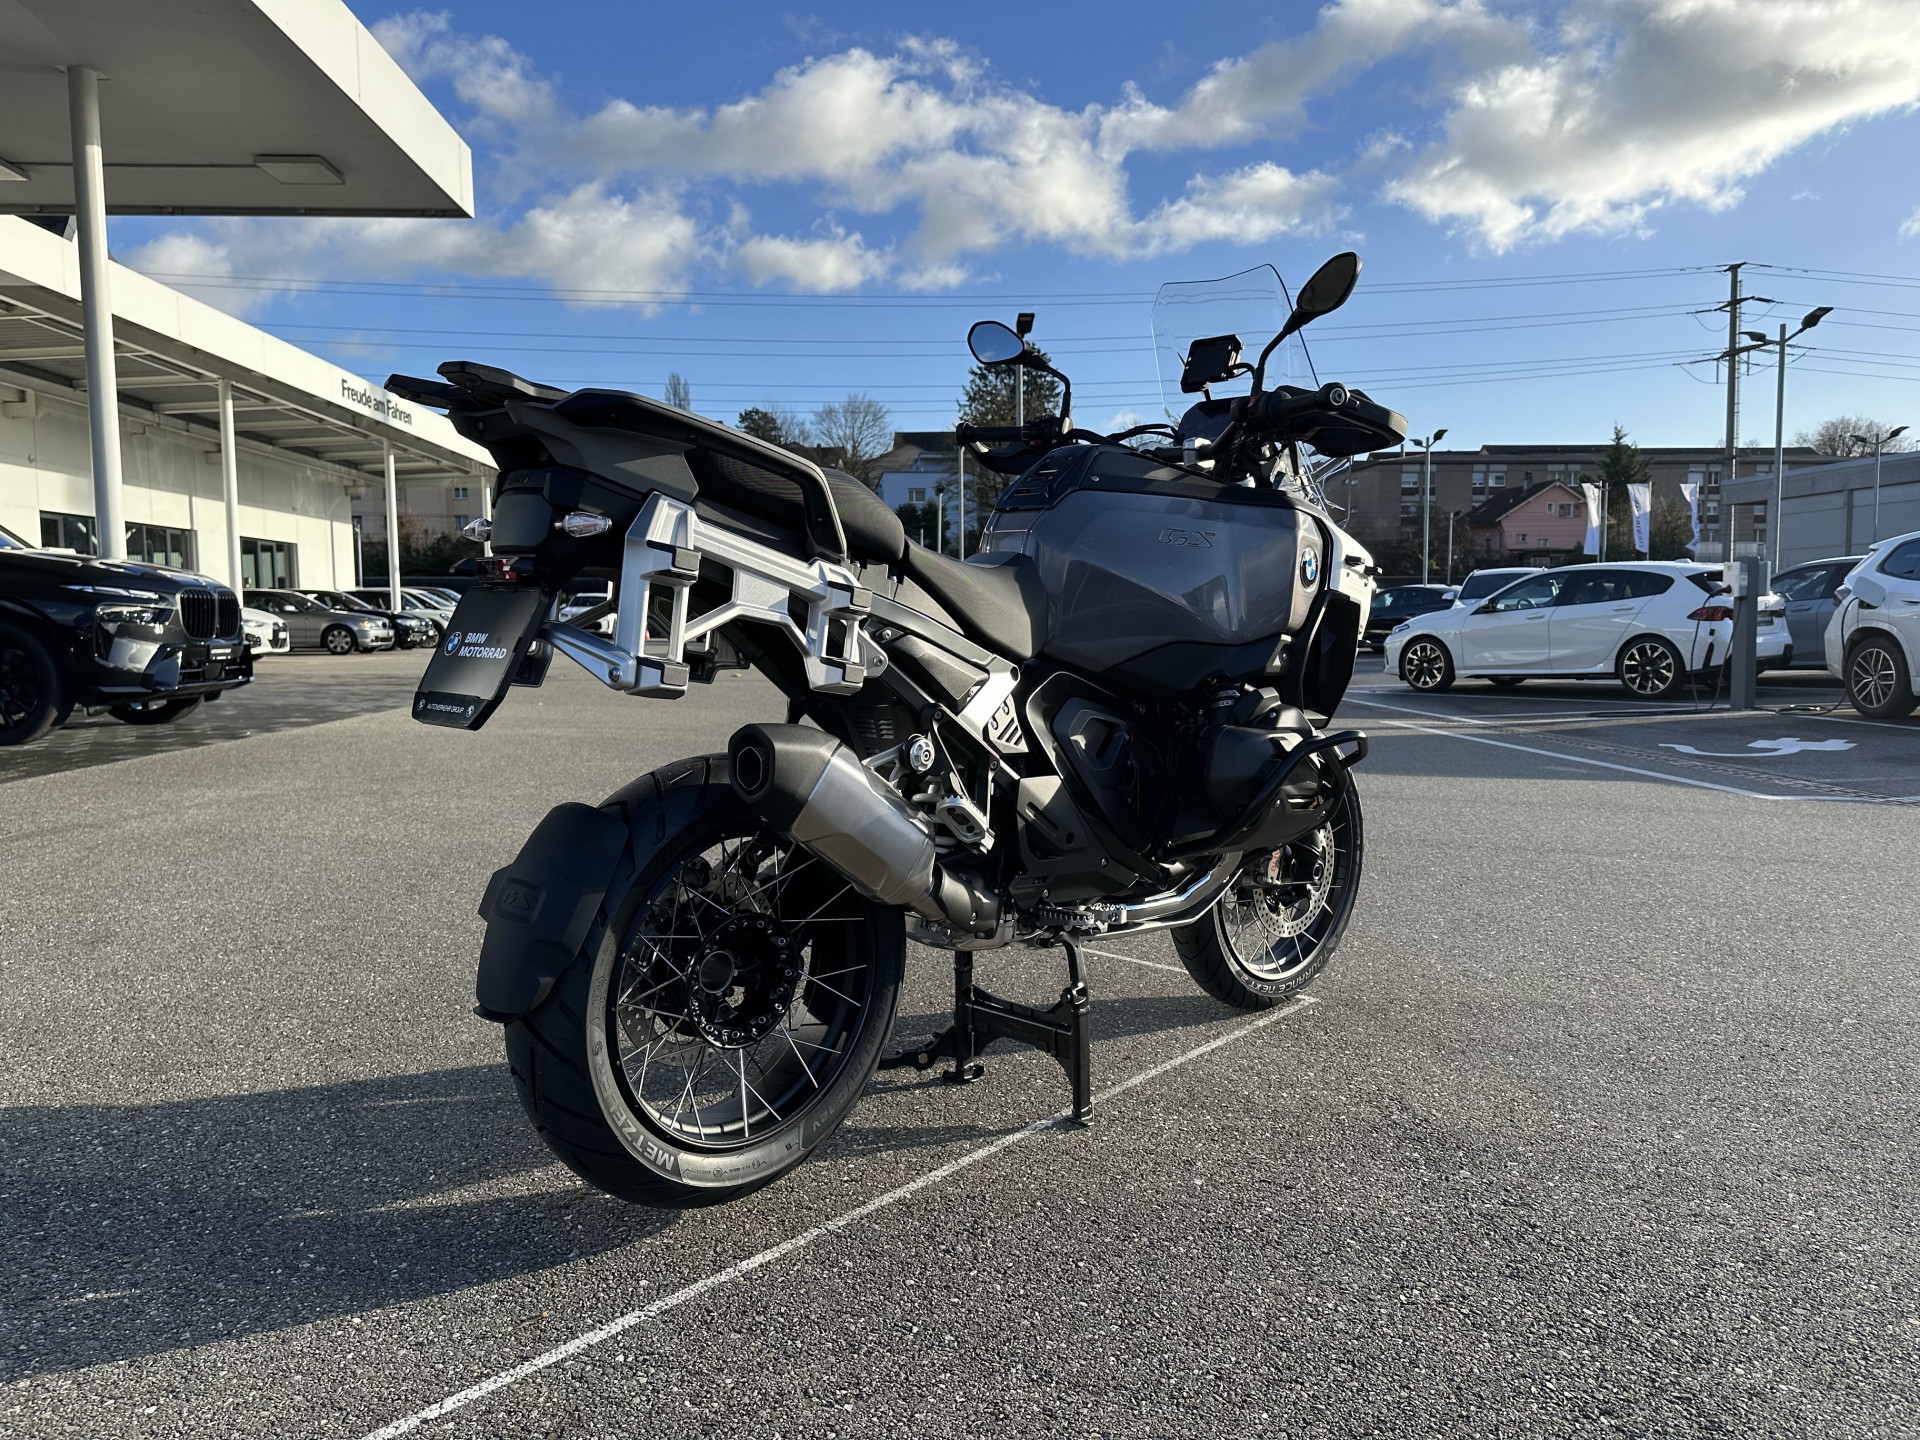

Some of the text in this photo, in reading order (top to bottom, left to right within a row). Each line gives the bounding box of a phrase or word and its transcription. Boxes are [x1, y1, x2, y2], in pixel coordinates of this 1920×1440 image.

[341, 378, 412, 426] Freude am Fahren
[1158, 528, 1216, 548] GS
[458, 646, 507, 659] MOTORRAD
[464, 632, 488, 644] BMW
[1278, 949, 1328, 993] TOURANCE
[595, 1058, 675, 1171] METZELER
